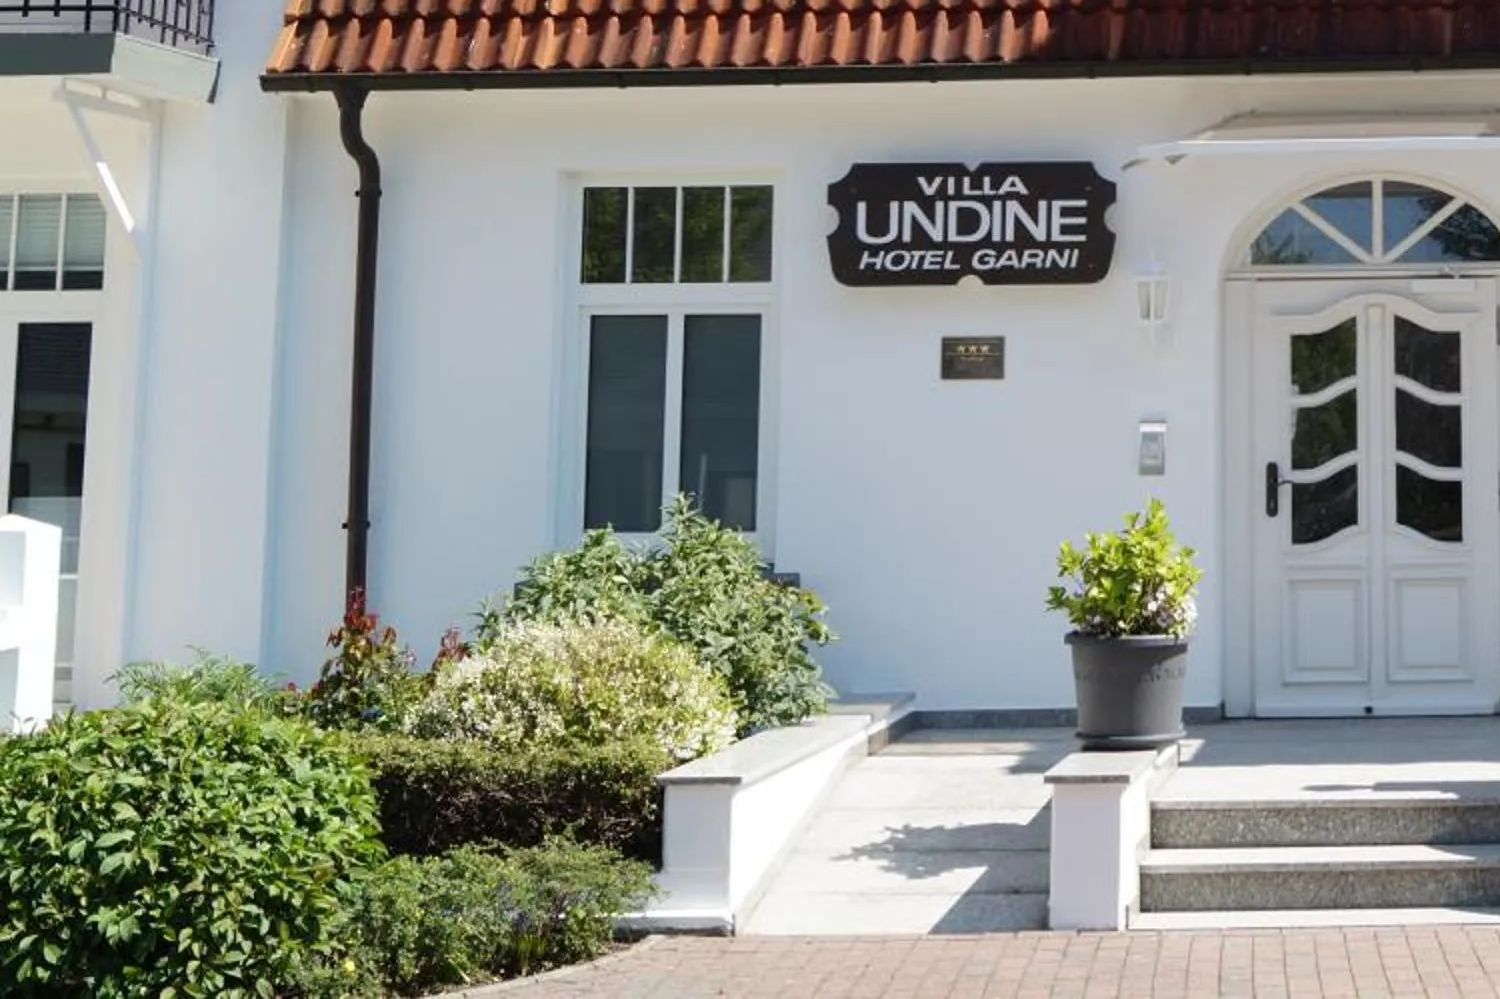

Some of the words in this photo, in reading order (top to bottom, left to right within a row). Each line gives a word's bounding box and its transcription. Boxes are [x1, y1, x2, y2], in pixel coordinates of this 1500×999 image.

[916, 175, 1030, 196] VILLA
[856, 200, 1088, 243] UNDINE
[859, 250, 961, 271] HOTEL
[971, 248, 1080, 270] GARNI
